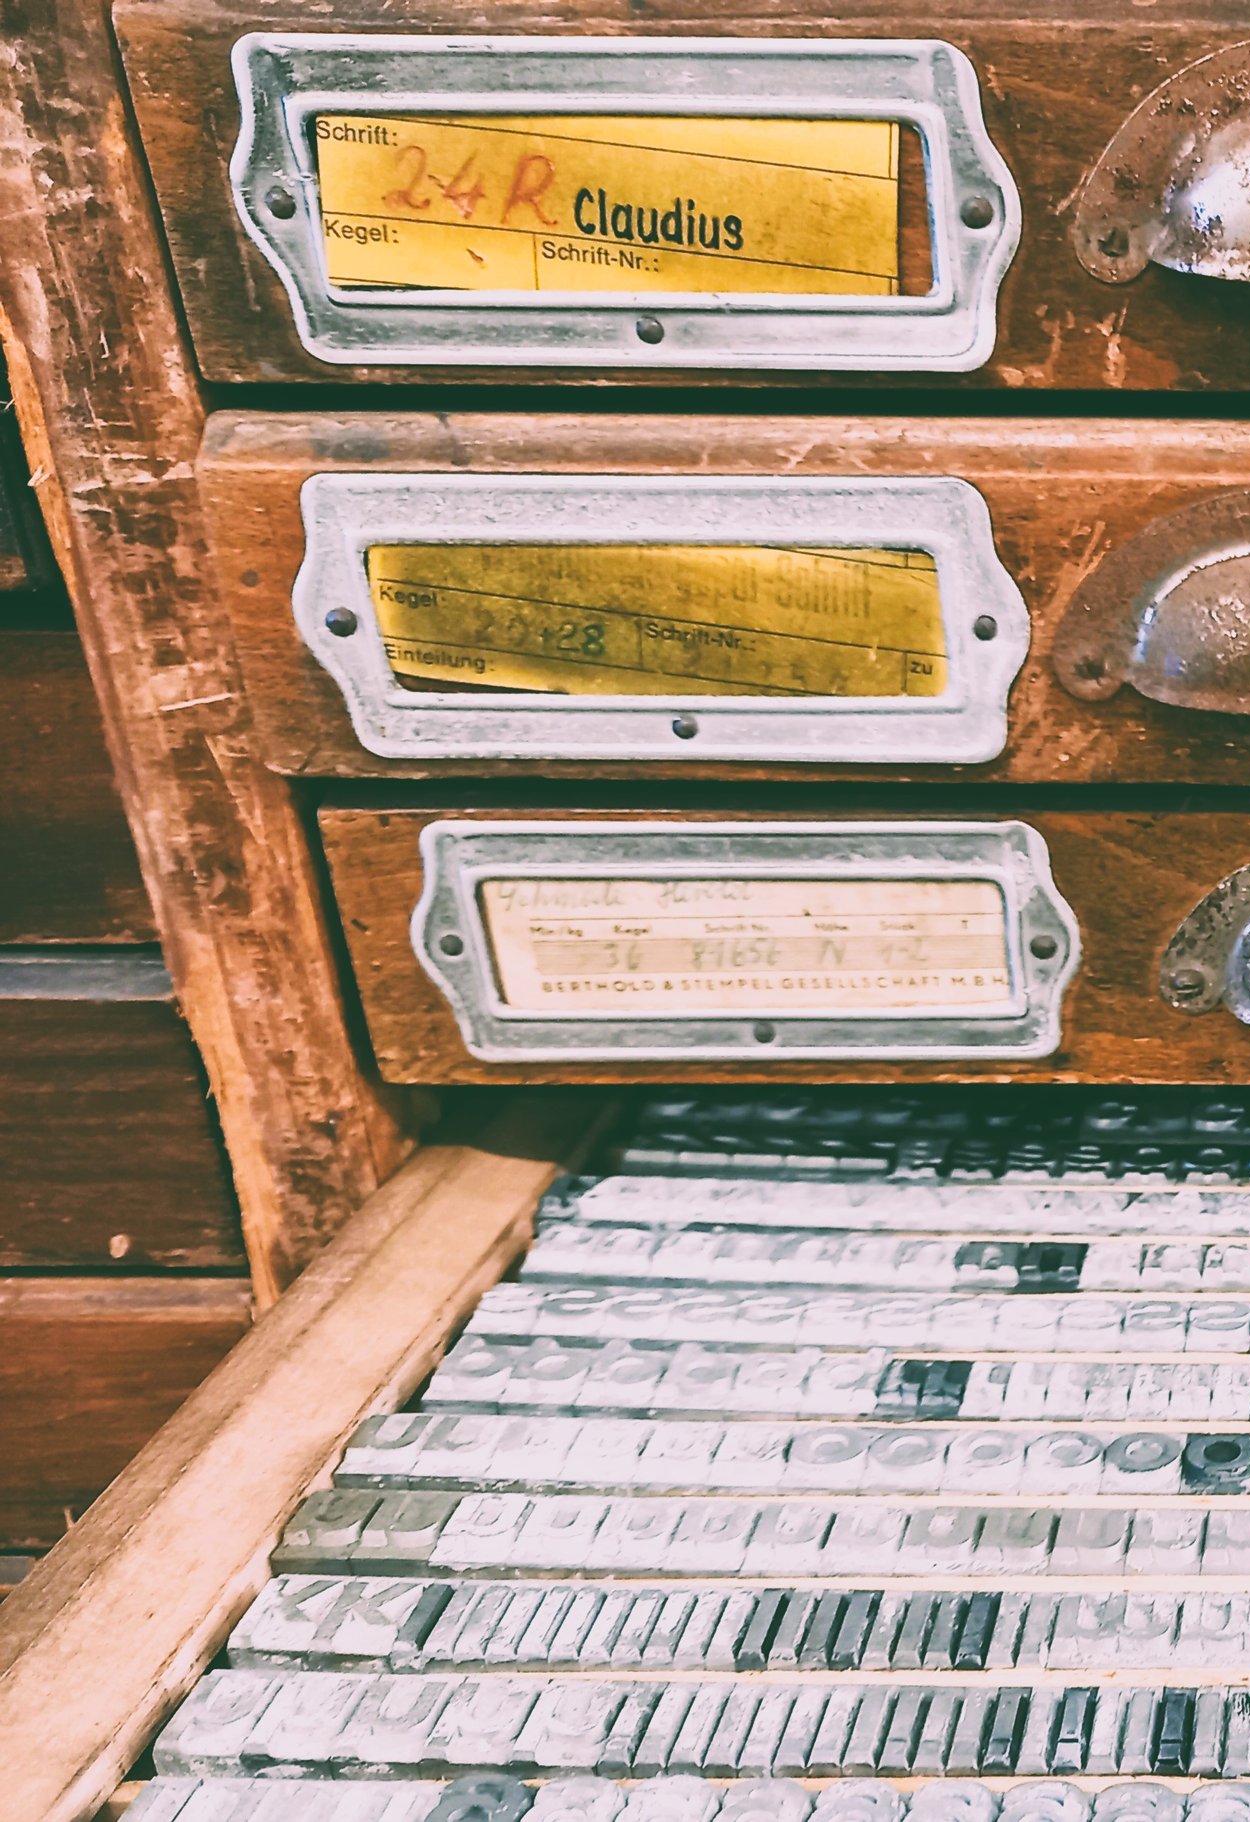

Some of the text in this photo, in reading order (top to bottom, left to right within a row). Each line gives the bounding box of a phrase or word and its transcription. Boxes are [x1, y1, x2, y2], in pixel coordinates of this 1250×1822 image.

[315, 120, 398, 147] Schrift:
[501, 154, 558, 226] R
[325, 218, 399, 245] Kegel:
[573, 187, 745, 251] Claudius
[541, 241, 660, 273] Schrift-Nr.:
[384, 642, 497, 674] Einteilung:
[909, 660, 934, 676] zu
[541, 979, 656, 994] BERTHOLD
[662, 979, 675, 992] &
